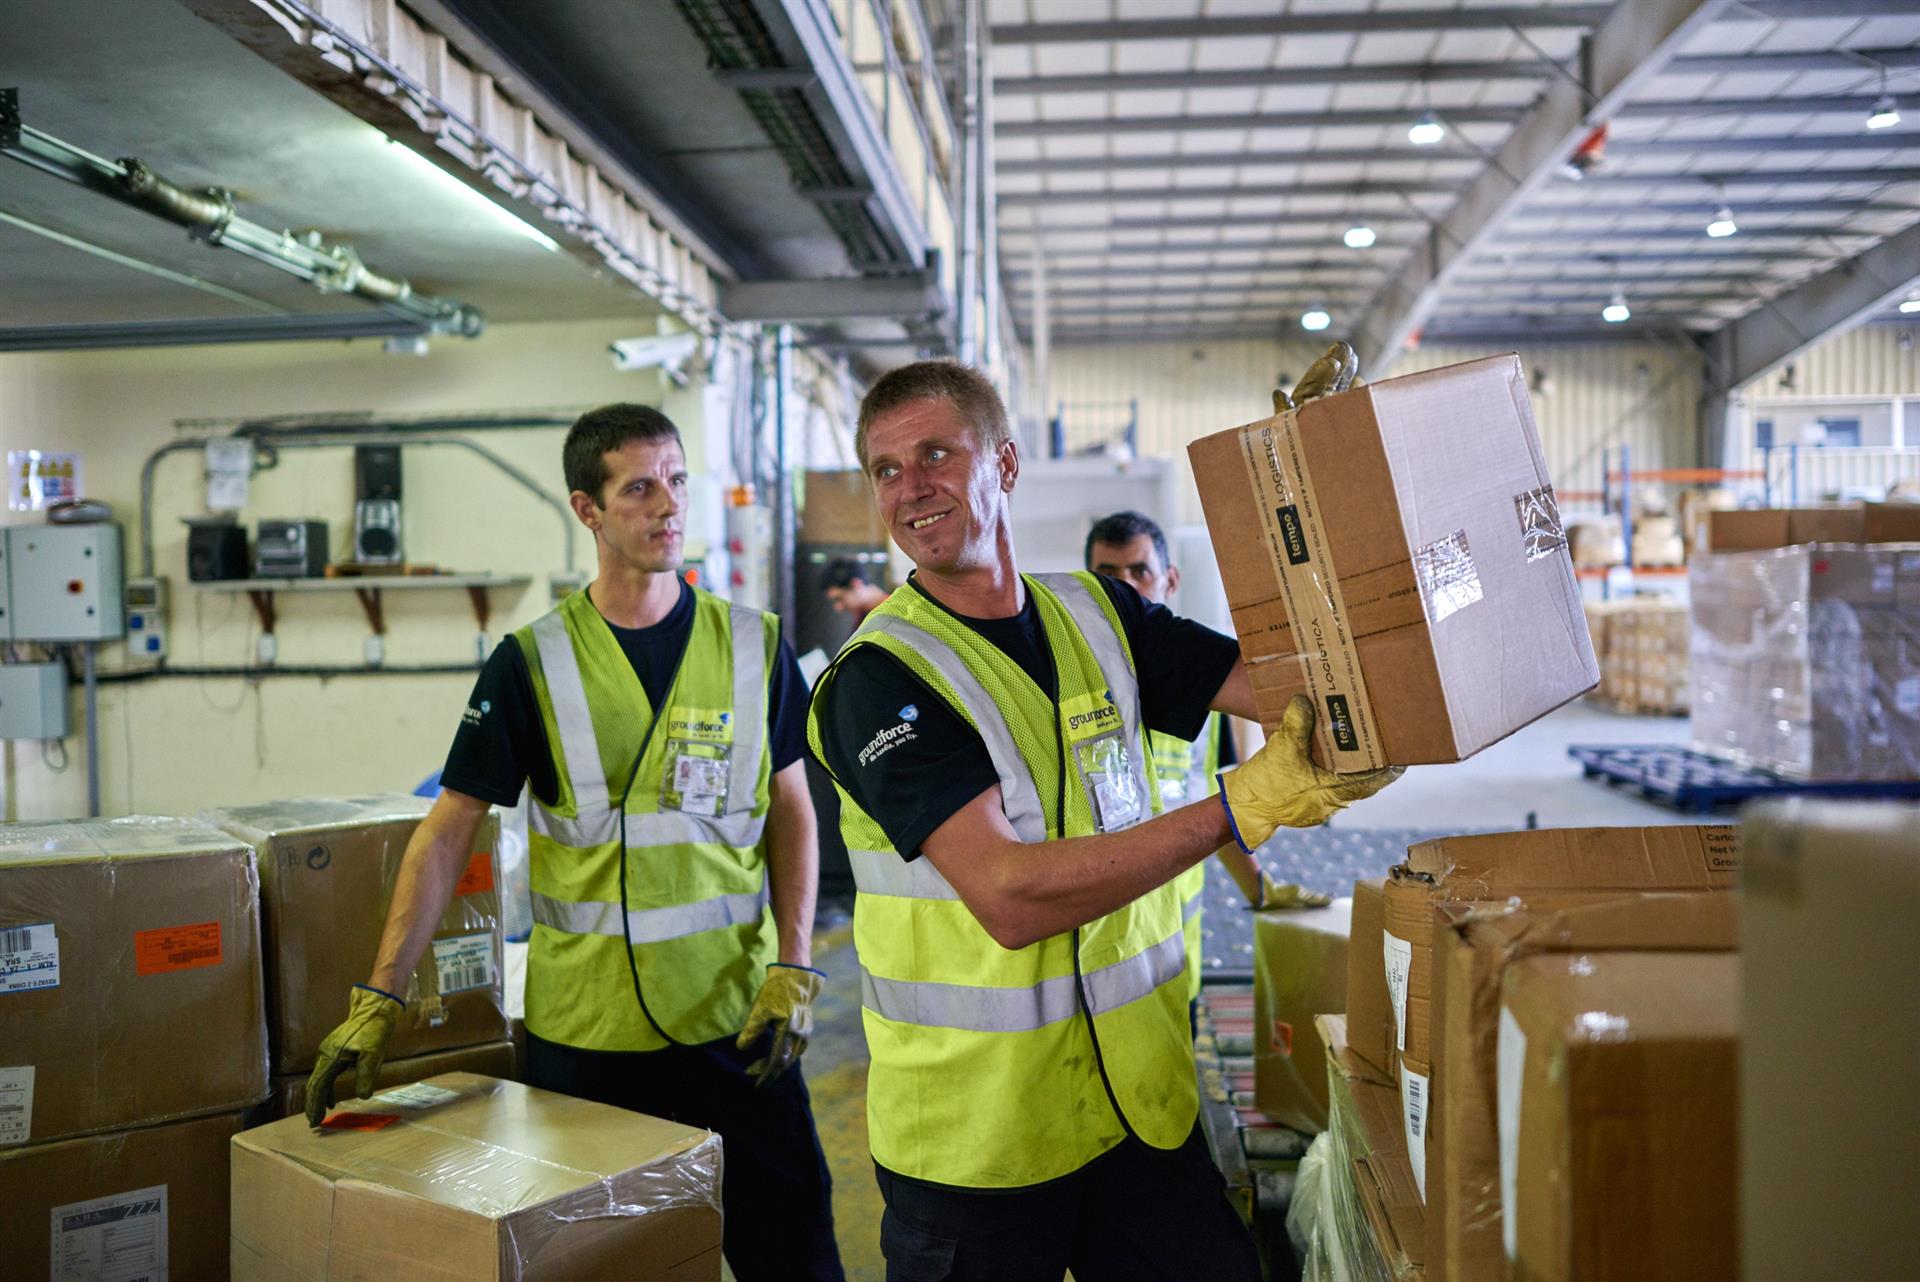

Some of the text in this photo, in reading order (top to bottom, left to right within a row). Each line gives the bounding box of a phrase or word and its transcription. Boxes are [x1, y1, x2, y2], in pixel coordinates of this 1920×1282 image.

[1262, 427, 1286, 502] LOGISTICS
[1284, 513, 1302, 557] tempe
[670, 720, 724, 732] groundforce
[1333, 702, 1349, 744] tempe
